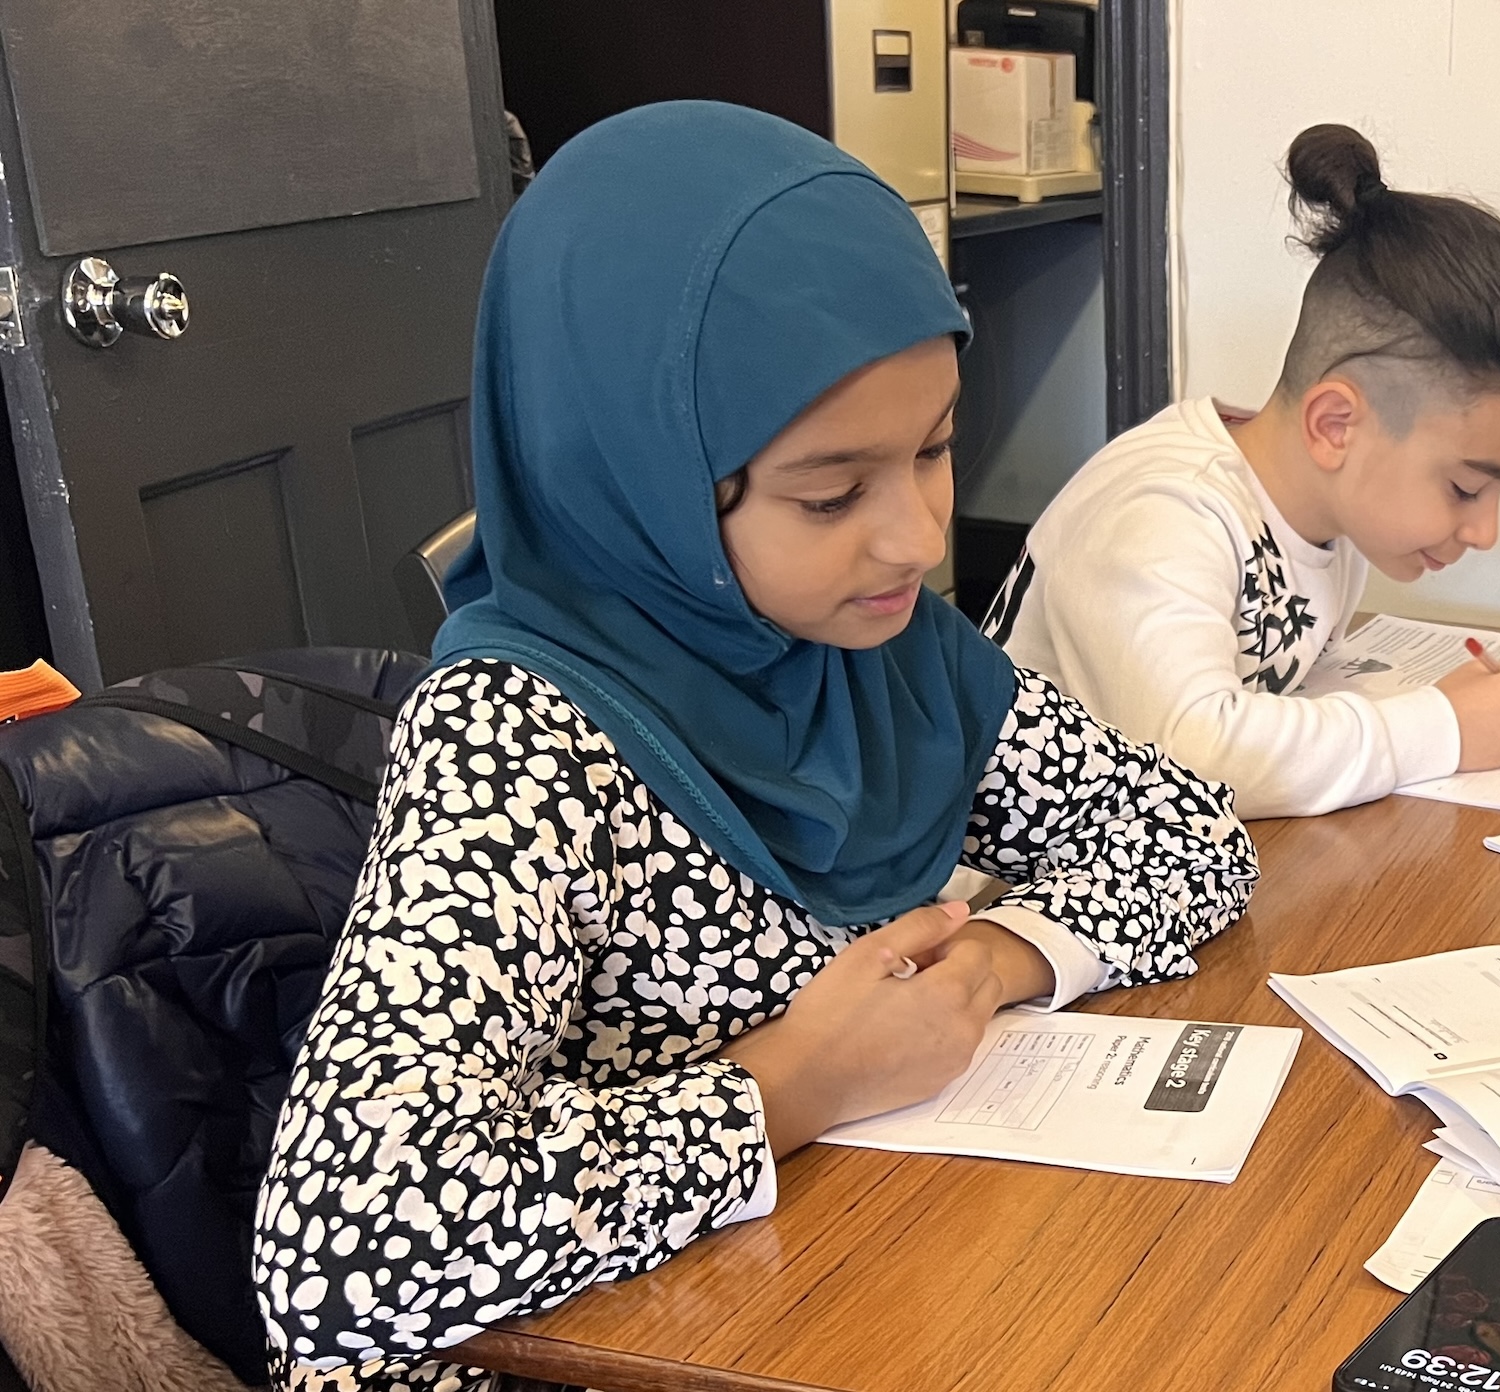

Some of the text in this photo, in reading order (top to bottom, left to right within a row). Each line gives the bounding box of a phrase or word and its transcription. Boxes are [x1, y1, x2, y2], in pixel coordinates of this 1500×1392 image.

[1109, 1034, 1128, 1053] Paper
[1114, 1036, 1152, 1087] Mathematics
[1165, 1028, 1212, 1089] Key stage 2
[1087, 1058, 1113, 1091] reasoning
